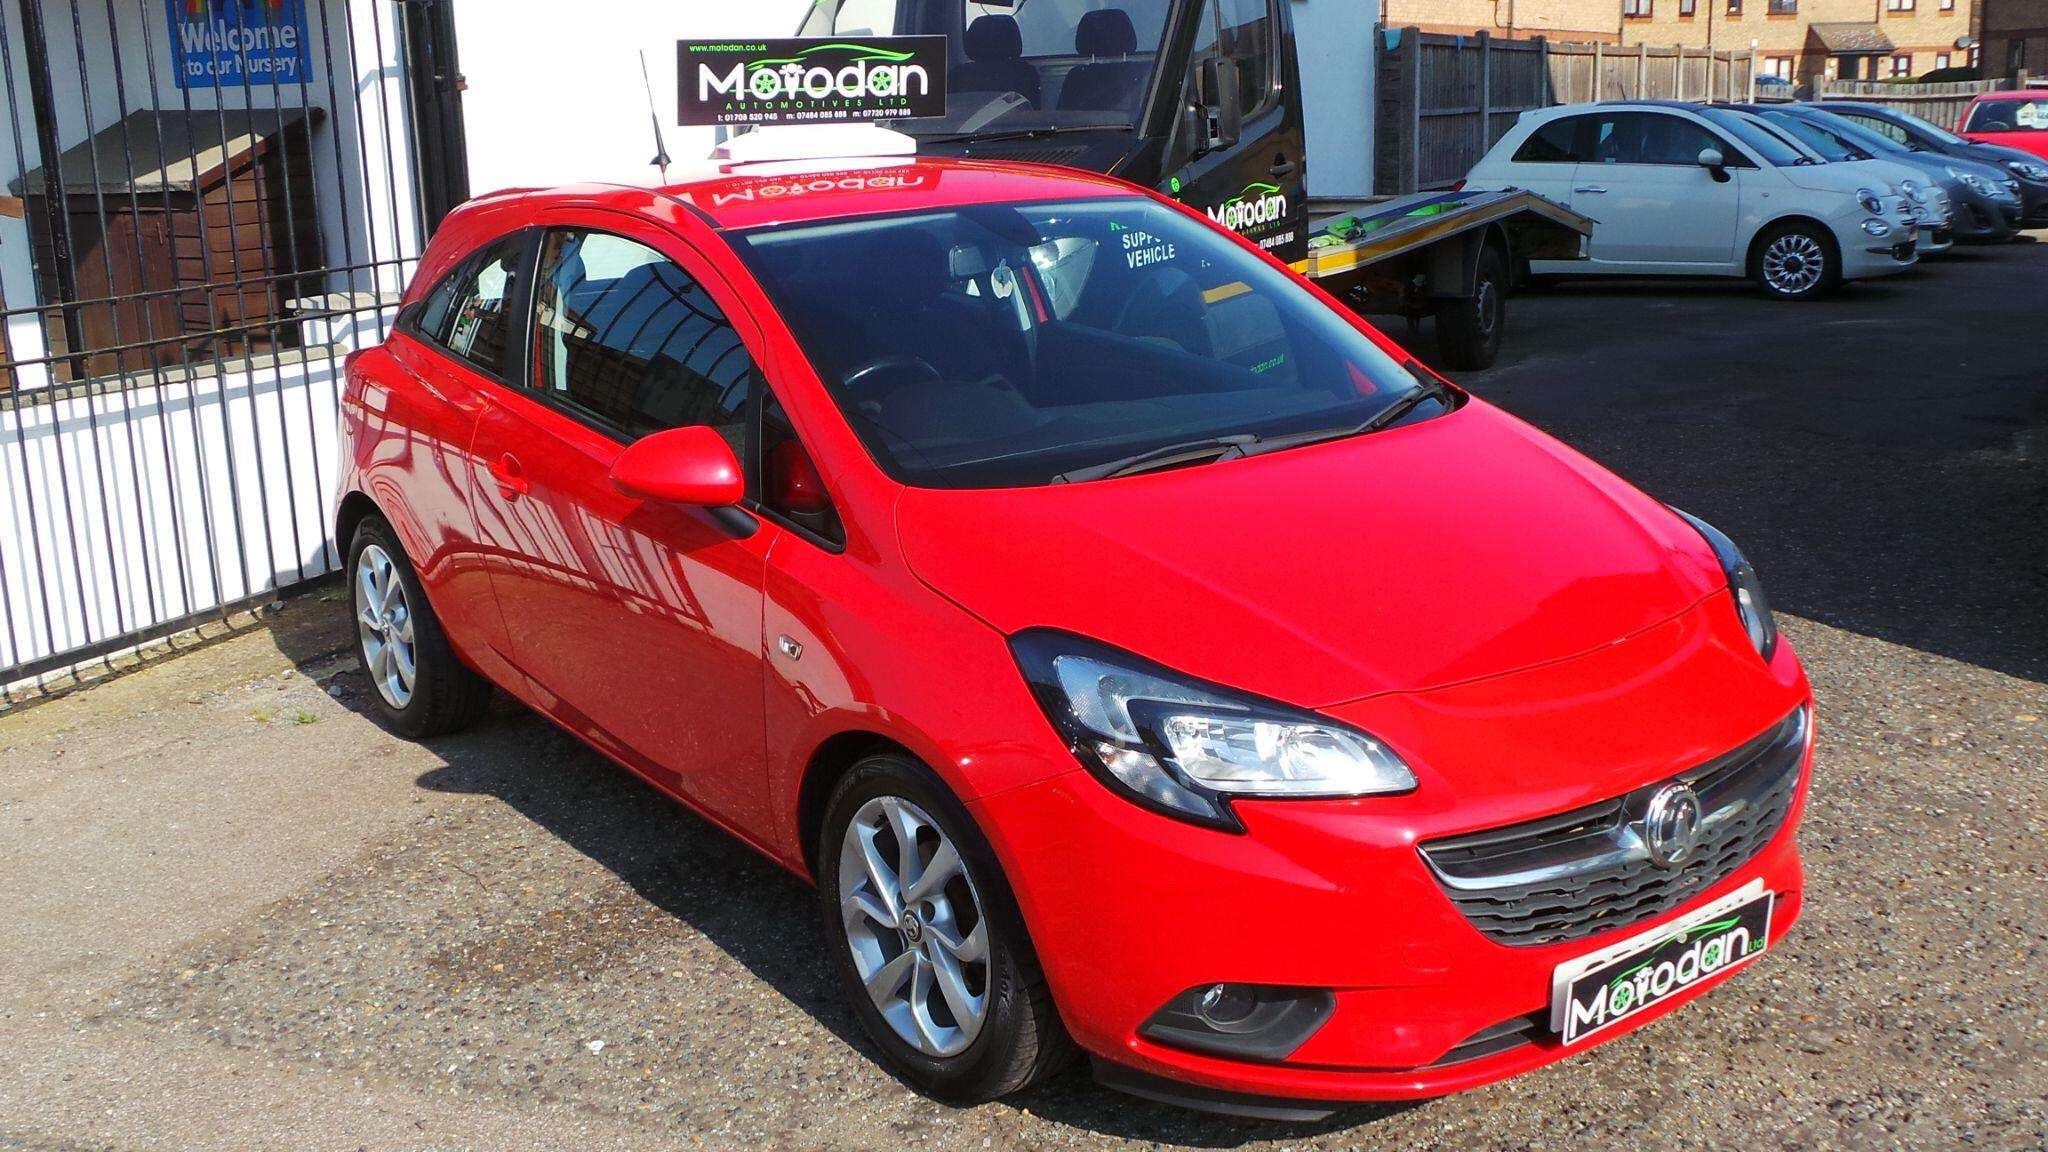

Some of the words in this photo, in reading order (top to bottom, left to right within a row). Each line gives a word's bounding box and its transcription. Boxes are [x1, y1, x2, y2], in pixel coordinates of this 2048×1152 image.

[178, 19, 297, 53] Welcome
[689, 43, 767, 52] www.motodan.co.uk
[186, 59, 204, 76] to
[699, 60, 928, 101] Motodan
[725, 99, 862, 110] AUTOMOTIVES
[879, 98, 908, 106] LTD
[749, 112, 763, 121] 520
[764, 112, 778, 120] 945
[862, 109, 884, 117] 07720
[885, 108, 897, 116] 979
[1207, 194, 1286, 231] Motodan
[1126, 243, 1176, 269] VEHICLE
[1569, 927, 1750, 1039] Motodan
